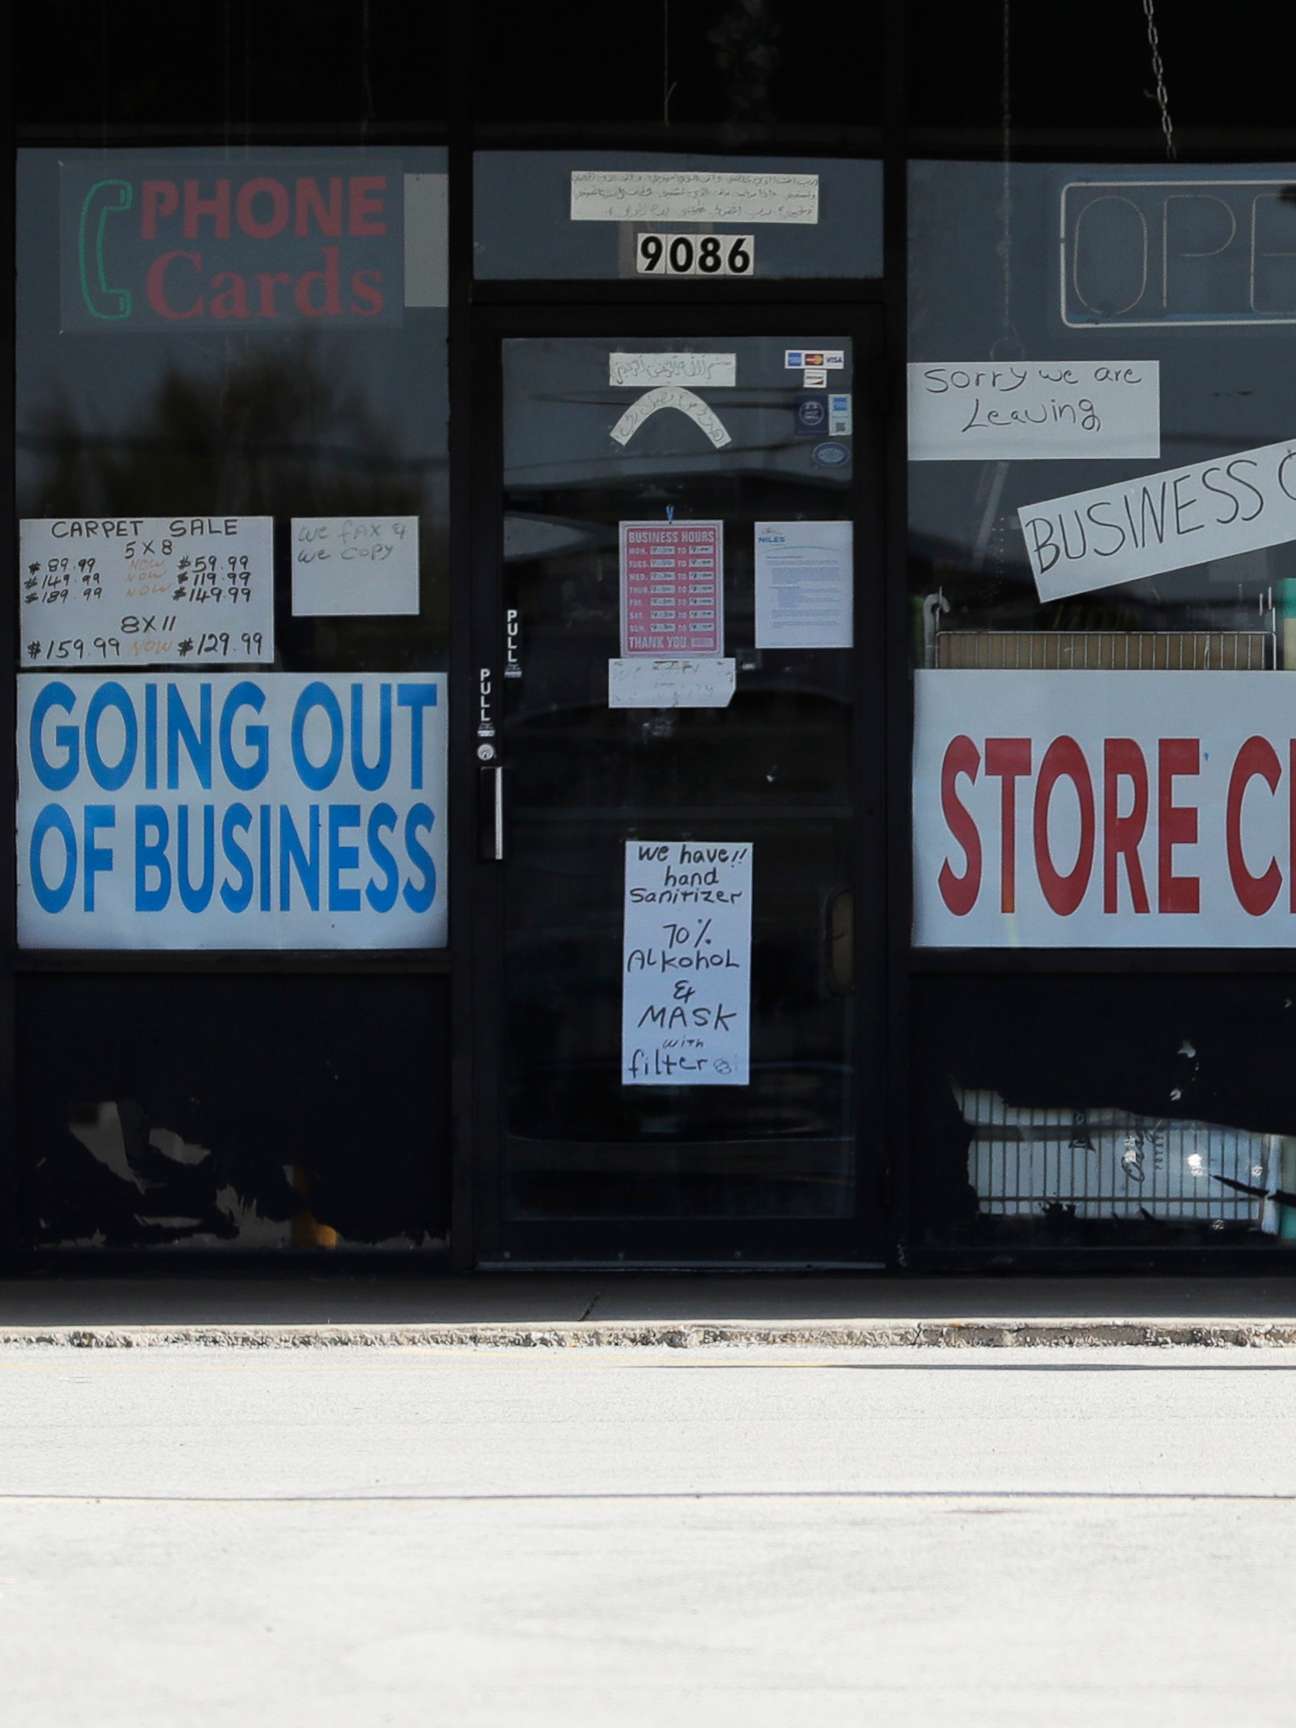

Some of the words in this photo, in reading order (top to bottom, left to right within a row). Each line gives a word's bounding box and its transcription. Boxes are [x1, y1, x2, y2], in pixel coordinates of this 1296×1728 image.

[139, 176, 386, 240] PHONE
[640, 235, 750, 274] 9086
[145, 246, 385, 320] Cards
[923, 367, 1027, 393] Sorry
[1038, 367, 1079, 384] we
[1094, 366, 1142, 384] are
[961, 398, 1100, 432] Leaving
[51, 520, 144, 538] CARPET
[169, 518, 238, 537] SALE
[1024, 459, 1264, 575] BUSINESS
[628, 531, 678, 543] BUSINESS
[681, 531, 714, 543] HOURS
[507, 609, 518, 663] PULL
[629, 637, 665, 648] THANK
[667, 637, 687, 648] YOU
[480, 668, 491, 722] PULL
[30, 681, 270, 791] GOING
[291, 681, 438, 791] OUT
[938, 734, 1200, 917] STORE
[30, 803, 116, 914] OF
[135, 802, 437, 914] BUSINESS
[664, 865, 719, 887] hand
[673, 980, 695, 1004] &
[628, 1048, 708, 1079] filter
